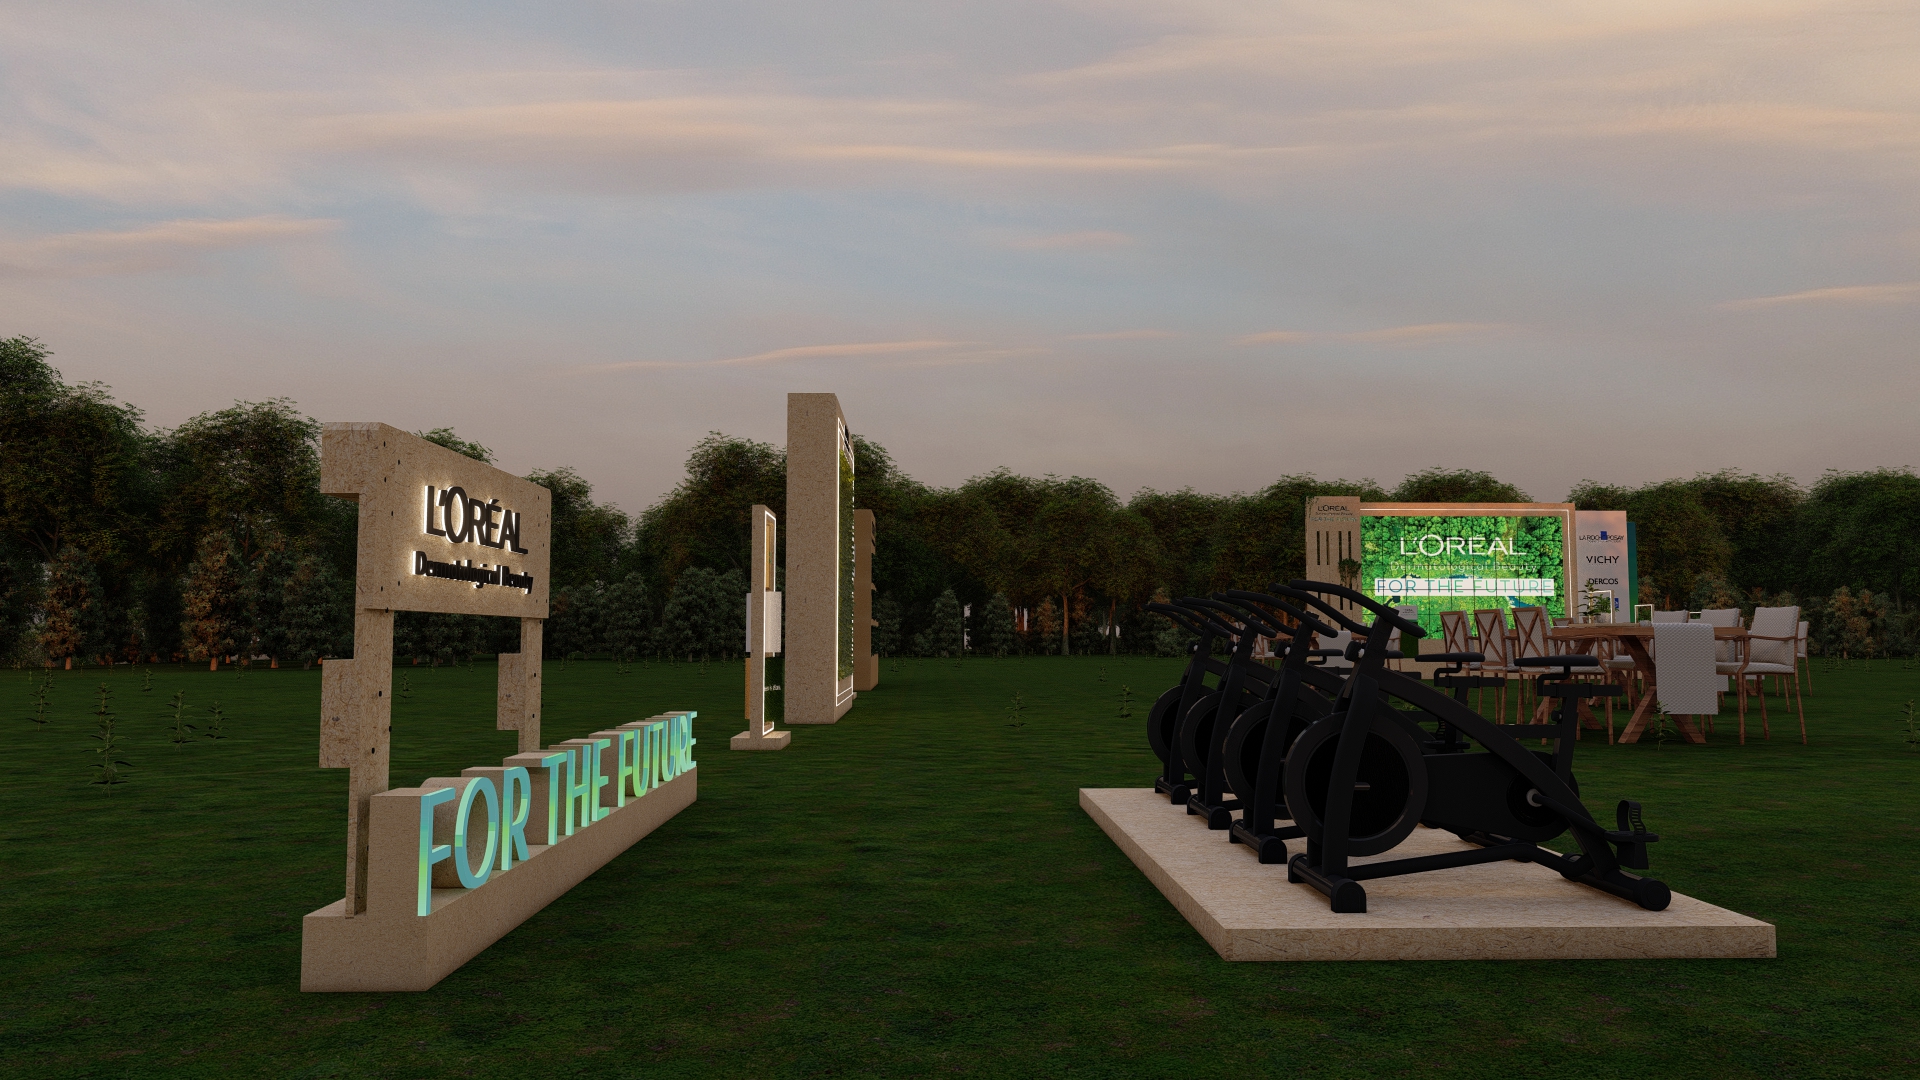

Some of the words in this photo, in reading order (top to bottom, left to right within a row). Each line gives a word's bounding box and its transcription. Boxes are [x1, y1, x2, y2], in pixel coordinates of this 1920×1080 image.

[424, 485, 528, 554] L'ORÉAL
[1400, 534, 1527, 556] L'ORÉAL
[1586, 555, 1619, 563] VICHY
[1390, 561, 1488, 572] Dermatological
[1493, 561, 1537, 572] Beauty
[1377, 579, 1417, 593] FOR
[1425, 579, 1464, 593] THE
[1473, 579, 1553, 593] FUTURE
[1589, 577, 1618, 585] DERCOS
[417, 766, 531, 916] FOR
[541, 738, 611, 845] THE
[617, 711, 697, 807] FUTURE
